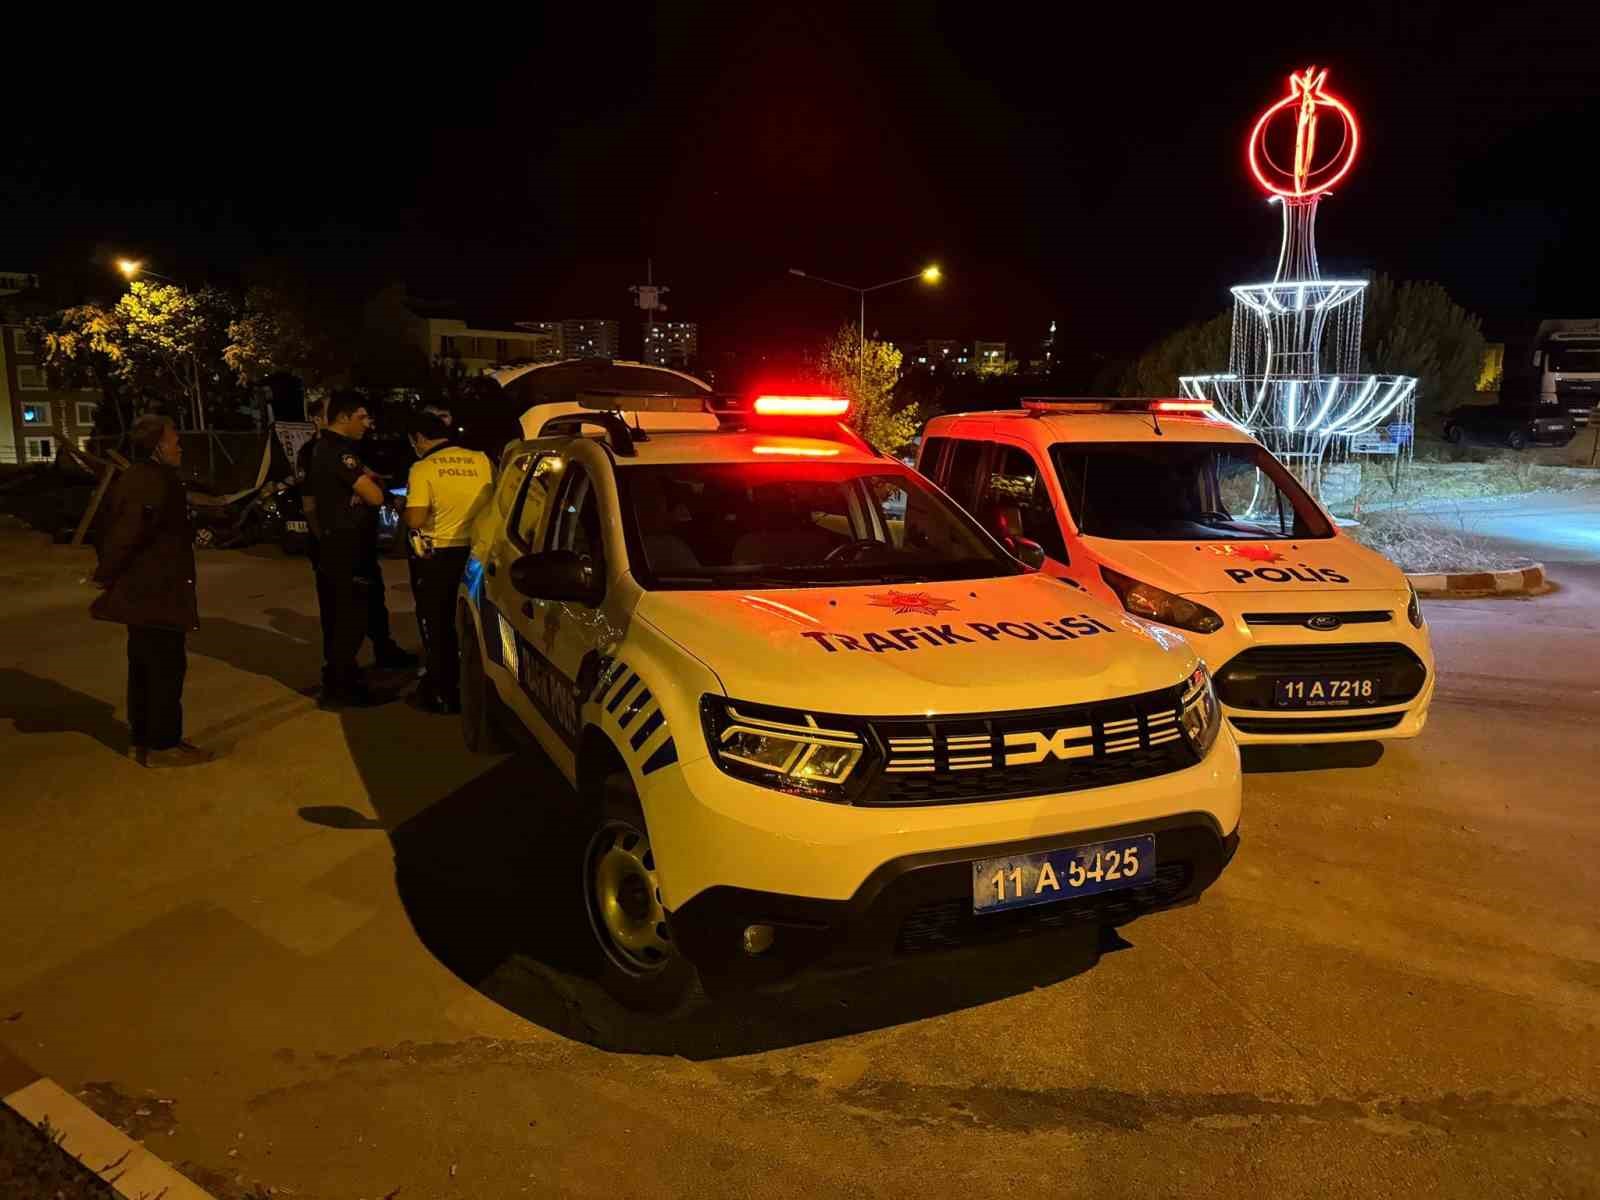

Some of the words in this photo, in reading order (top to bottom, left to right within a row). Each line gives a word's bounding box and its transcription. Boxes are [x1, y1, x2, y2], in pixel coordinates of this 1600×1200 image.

[1284, 682, 1305, 699] 11
[1309, 681, 1325, 698] A
[1329, 679, 1373, 697] 7218
[992, 866, 1024, 901] 11
[1033, 860, 1061, 895] A
[1067, 846, 1140, 888] 5425
